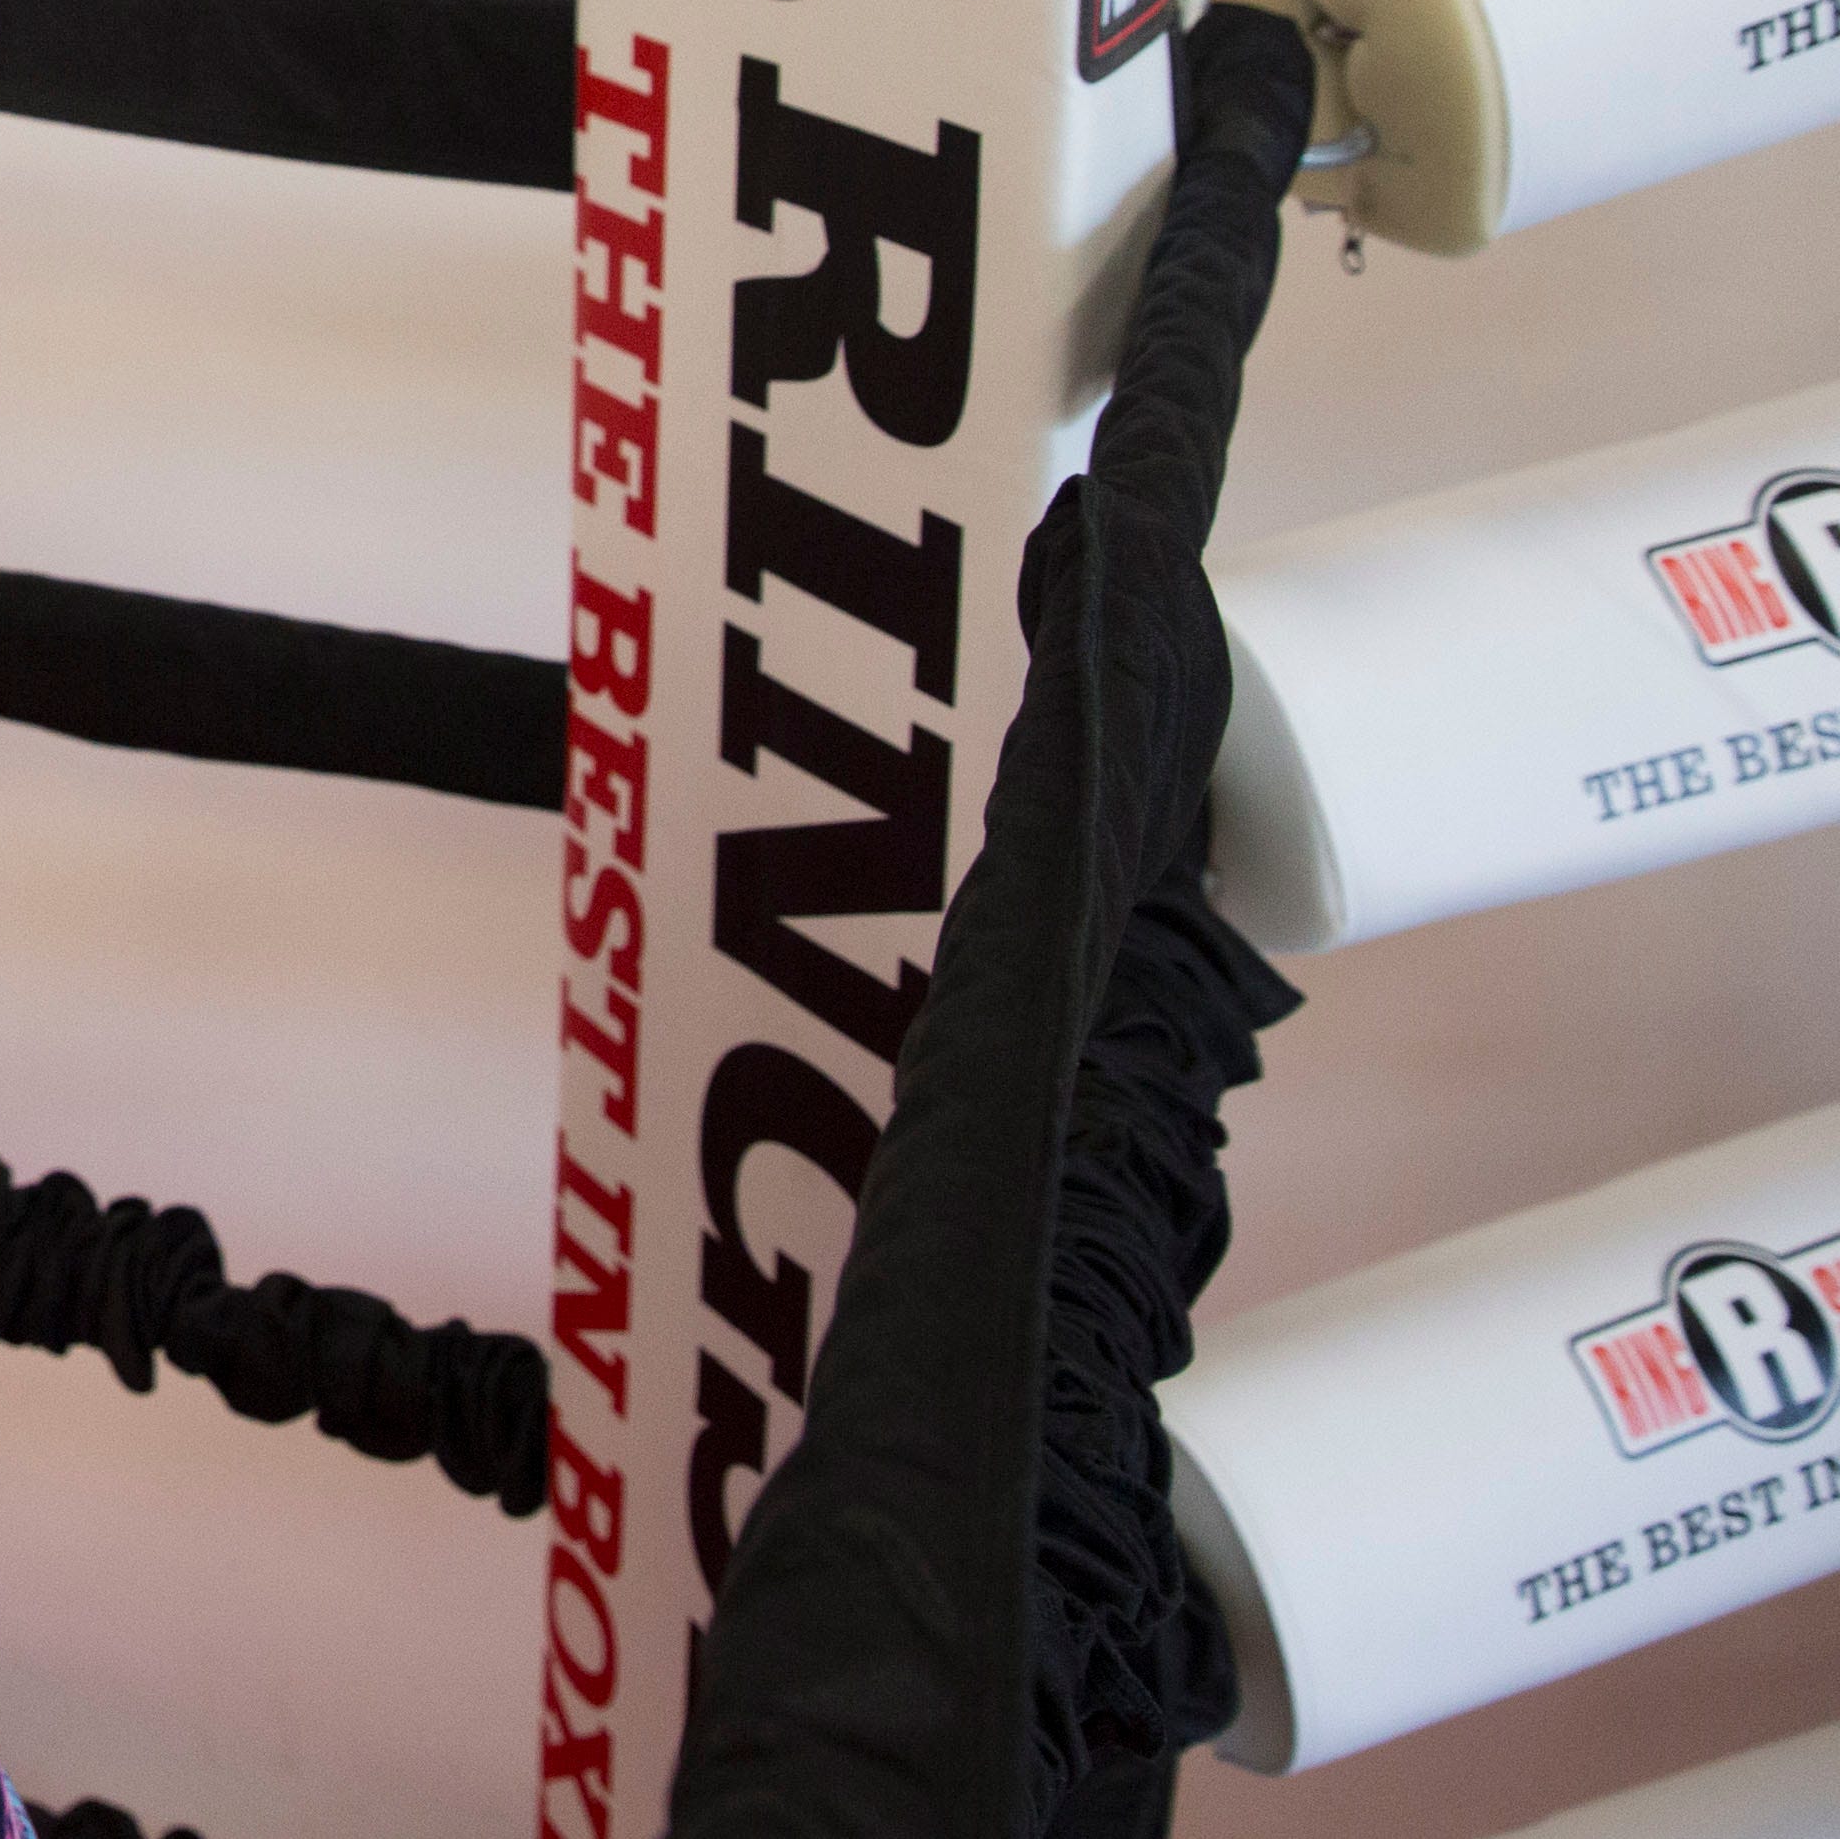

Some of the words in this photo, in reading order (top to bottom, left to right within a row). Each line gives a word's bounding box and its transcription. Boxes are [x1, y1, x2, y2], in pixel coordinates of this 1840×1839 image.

[567, 33, 671, 542] THE
[1660, 540, 1792, 646] RING
[555, 548, 655, 1139] BEST
[1583, 746, 1715, 823] THE
[551, 1127, 635, 1420] IN
[1591, 1322, 1710, 1439] RING
[1680, 1263, 1826, 1421] R
[1516, 1540, 1632, 1625] THE
[1642, 1476, 1785, 1573] BEST
